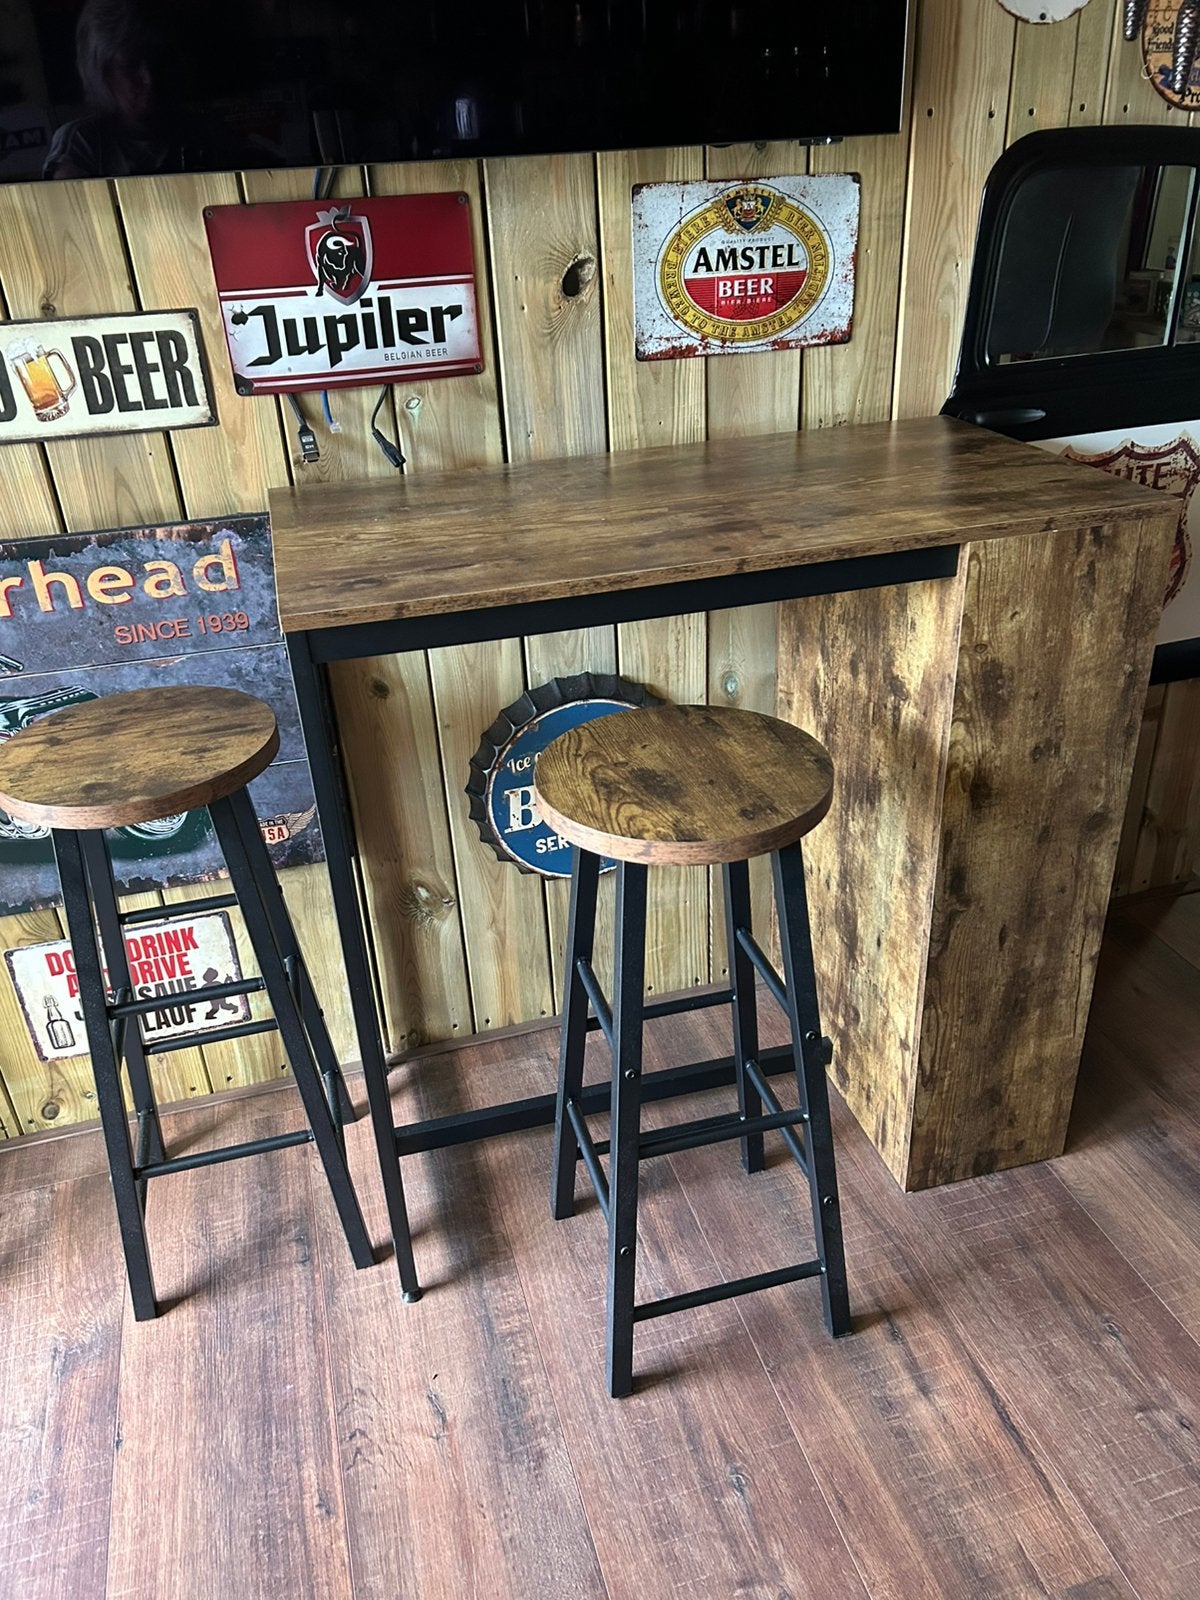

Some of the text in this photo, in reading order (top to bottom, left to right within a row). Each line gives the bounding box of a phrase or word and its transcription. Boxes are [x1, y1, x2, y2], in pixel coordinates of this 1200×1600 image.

[1148, 38, 1173, 51] Friend
[692, 243, 800, 273] AMSTEL
[666, 242, 826, 337] BREWED TO THE AMSTEL TRADITION
[718, 277, 774, 298] BEER
[247, 297, 463, 368] Jupiler
[384, 348, 448, 361] BELGIAN BEER
[71, 329, 200, 416] BEER
[115, 611, 249, 645] SINCE 1939
[126, 926, 199, 962] DRINK
[130, 952, 193, 987] DRIVE
[141, 1004, 197, 1033] LAUF
